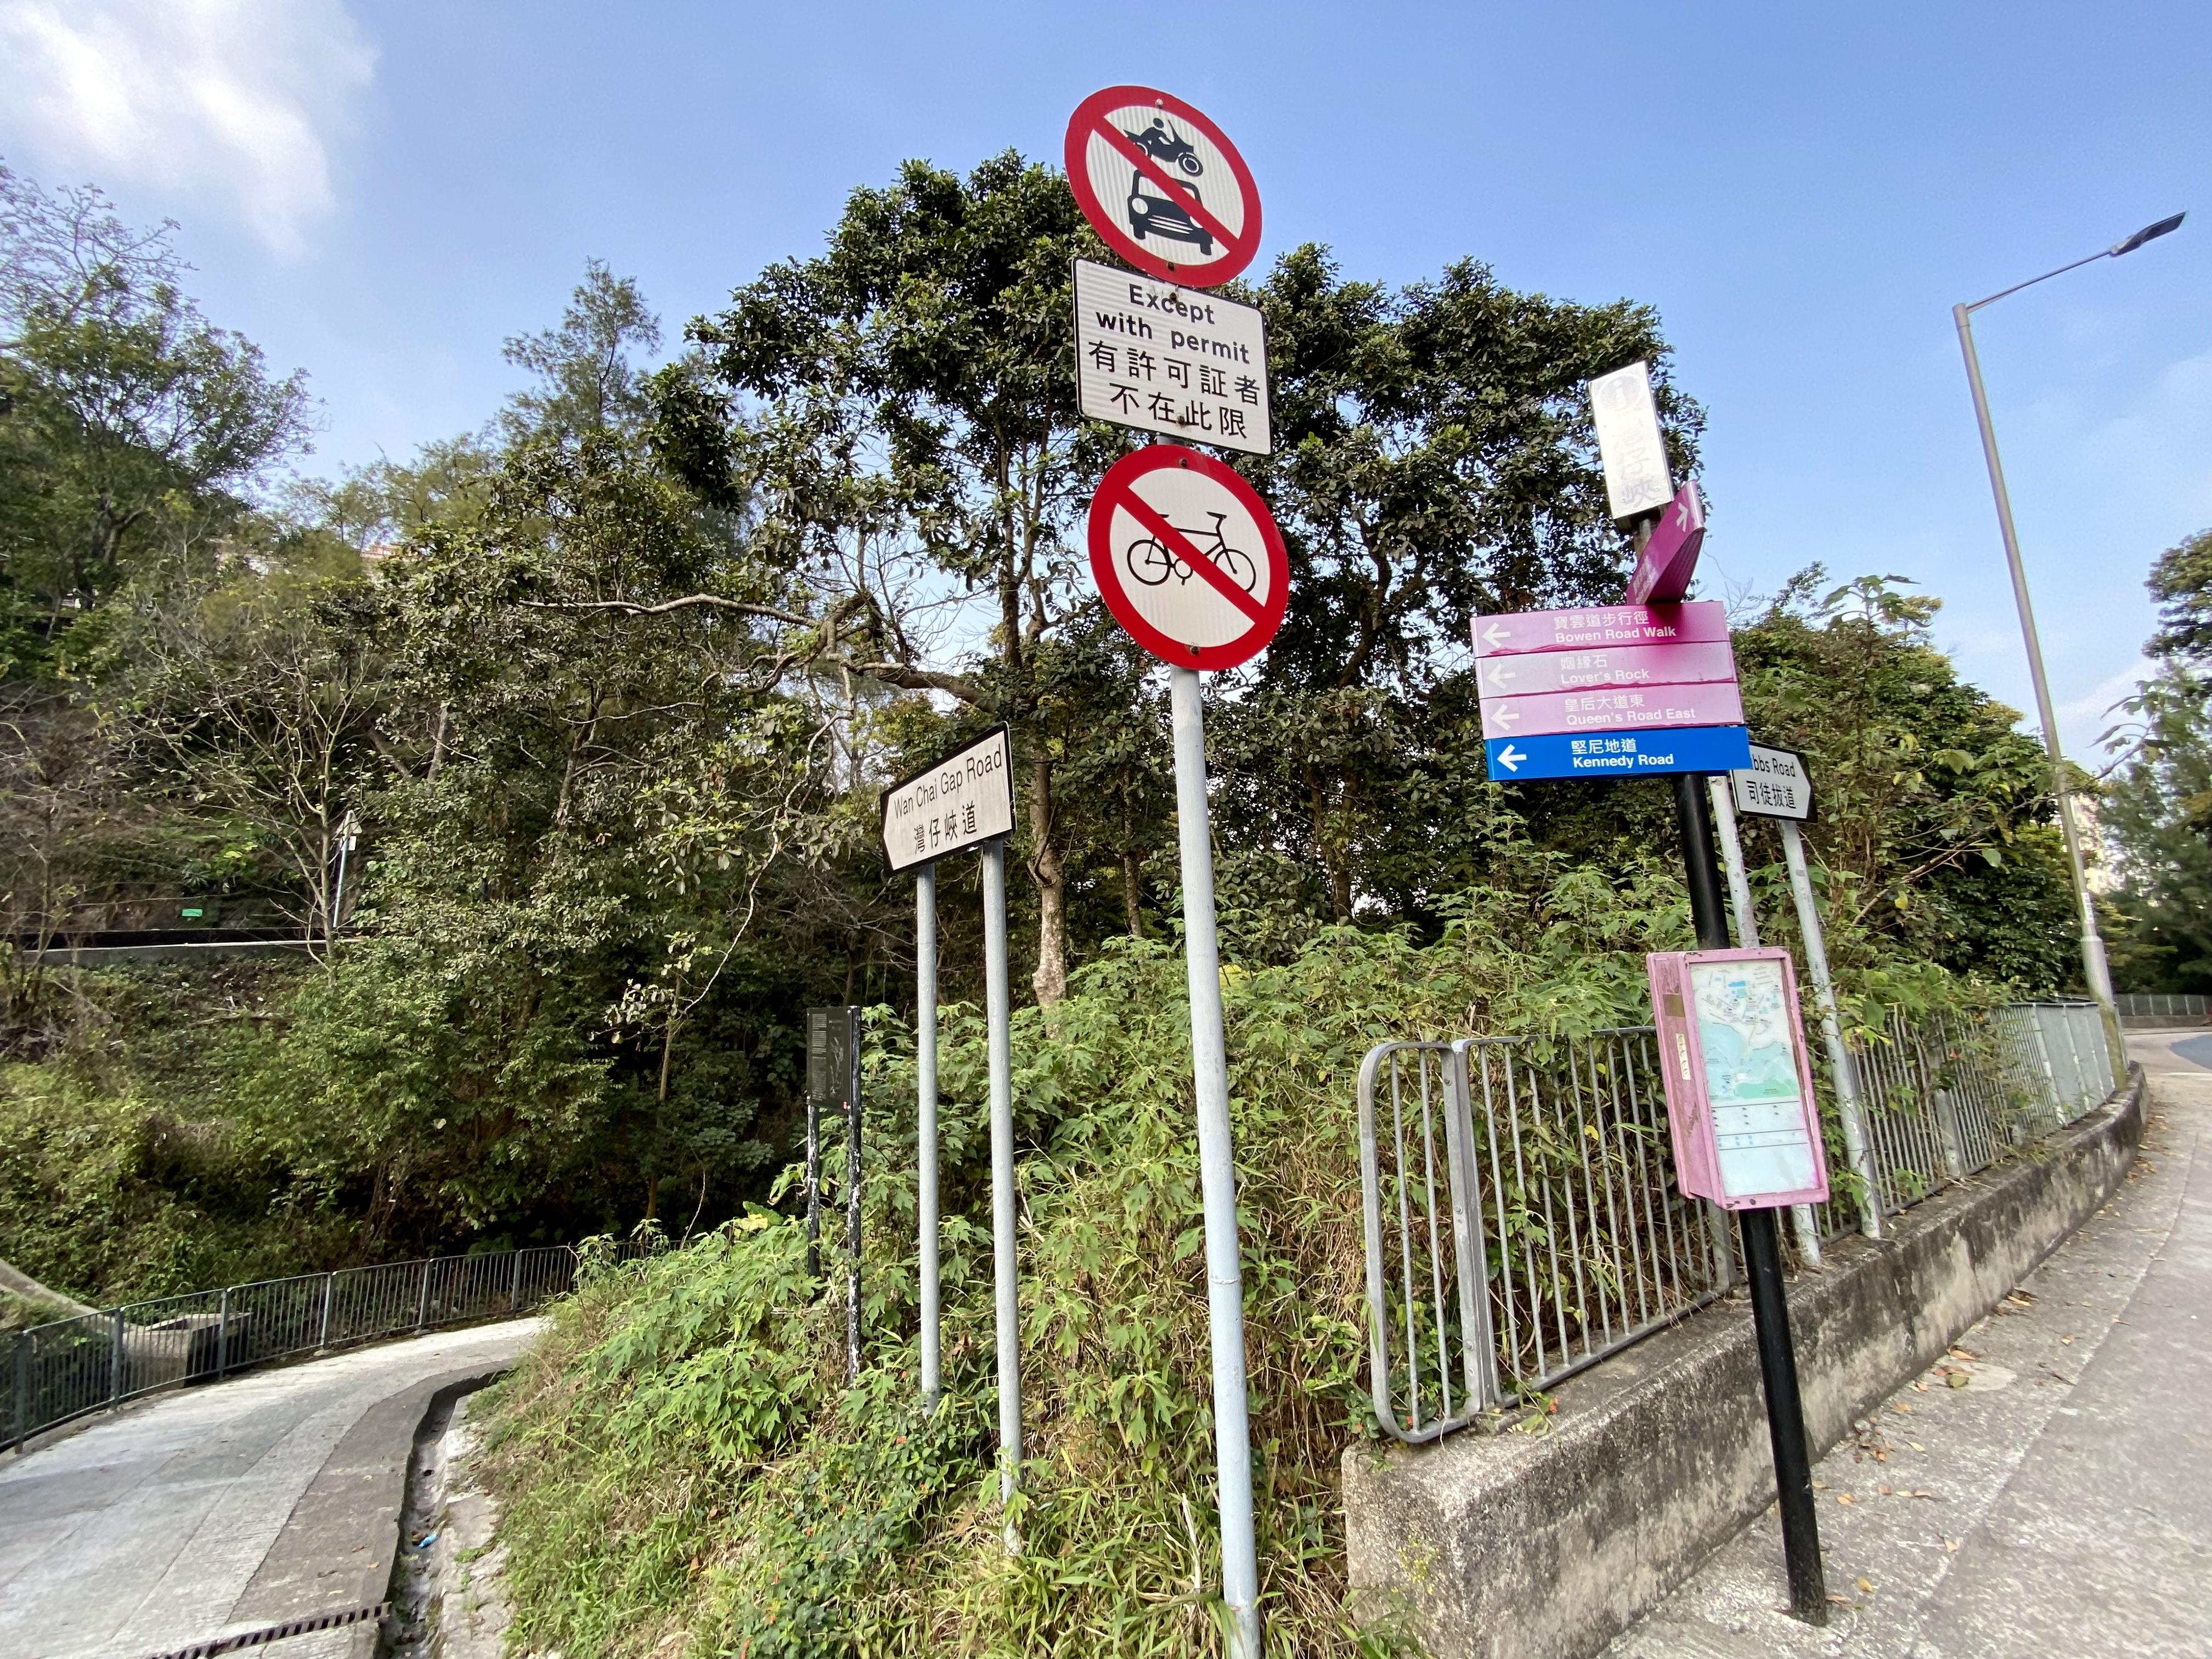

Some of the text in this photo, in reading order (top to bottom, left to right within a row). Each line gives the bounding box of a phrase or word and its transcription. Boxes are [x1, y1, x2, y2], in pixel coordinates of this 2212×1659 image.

[1128, 284, 1215, 325] Except
[1096, 312, 1250, 364] with permit
[1088, 340, 1260, 407] 有許可証者
[1109, 382, 1248, 438] 不在此限
[1554, 611, 1650, 630] 寶雲道步行徑
[1555, 626, 1677, 644] Bowen Road Walk
[1560, 668, 1650, 685] Lover's Rock
[1565, 693, 1645, 712] 皇后大道東
[1567, 708, 1696, 726] Queen's Road East
[1571, 738, 1637, 755] 堅尼地道
[1573, 754, 1674, 769] Kennedy Road
[1752, 754, 1796, 777] bbs Road
[894, 743, 1002, 819] Wan Chai Gap Road
[1746, 781, 1796, 809] 司徒拔道
